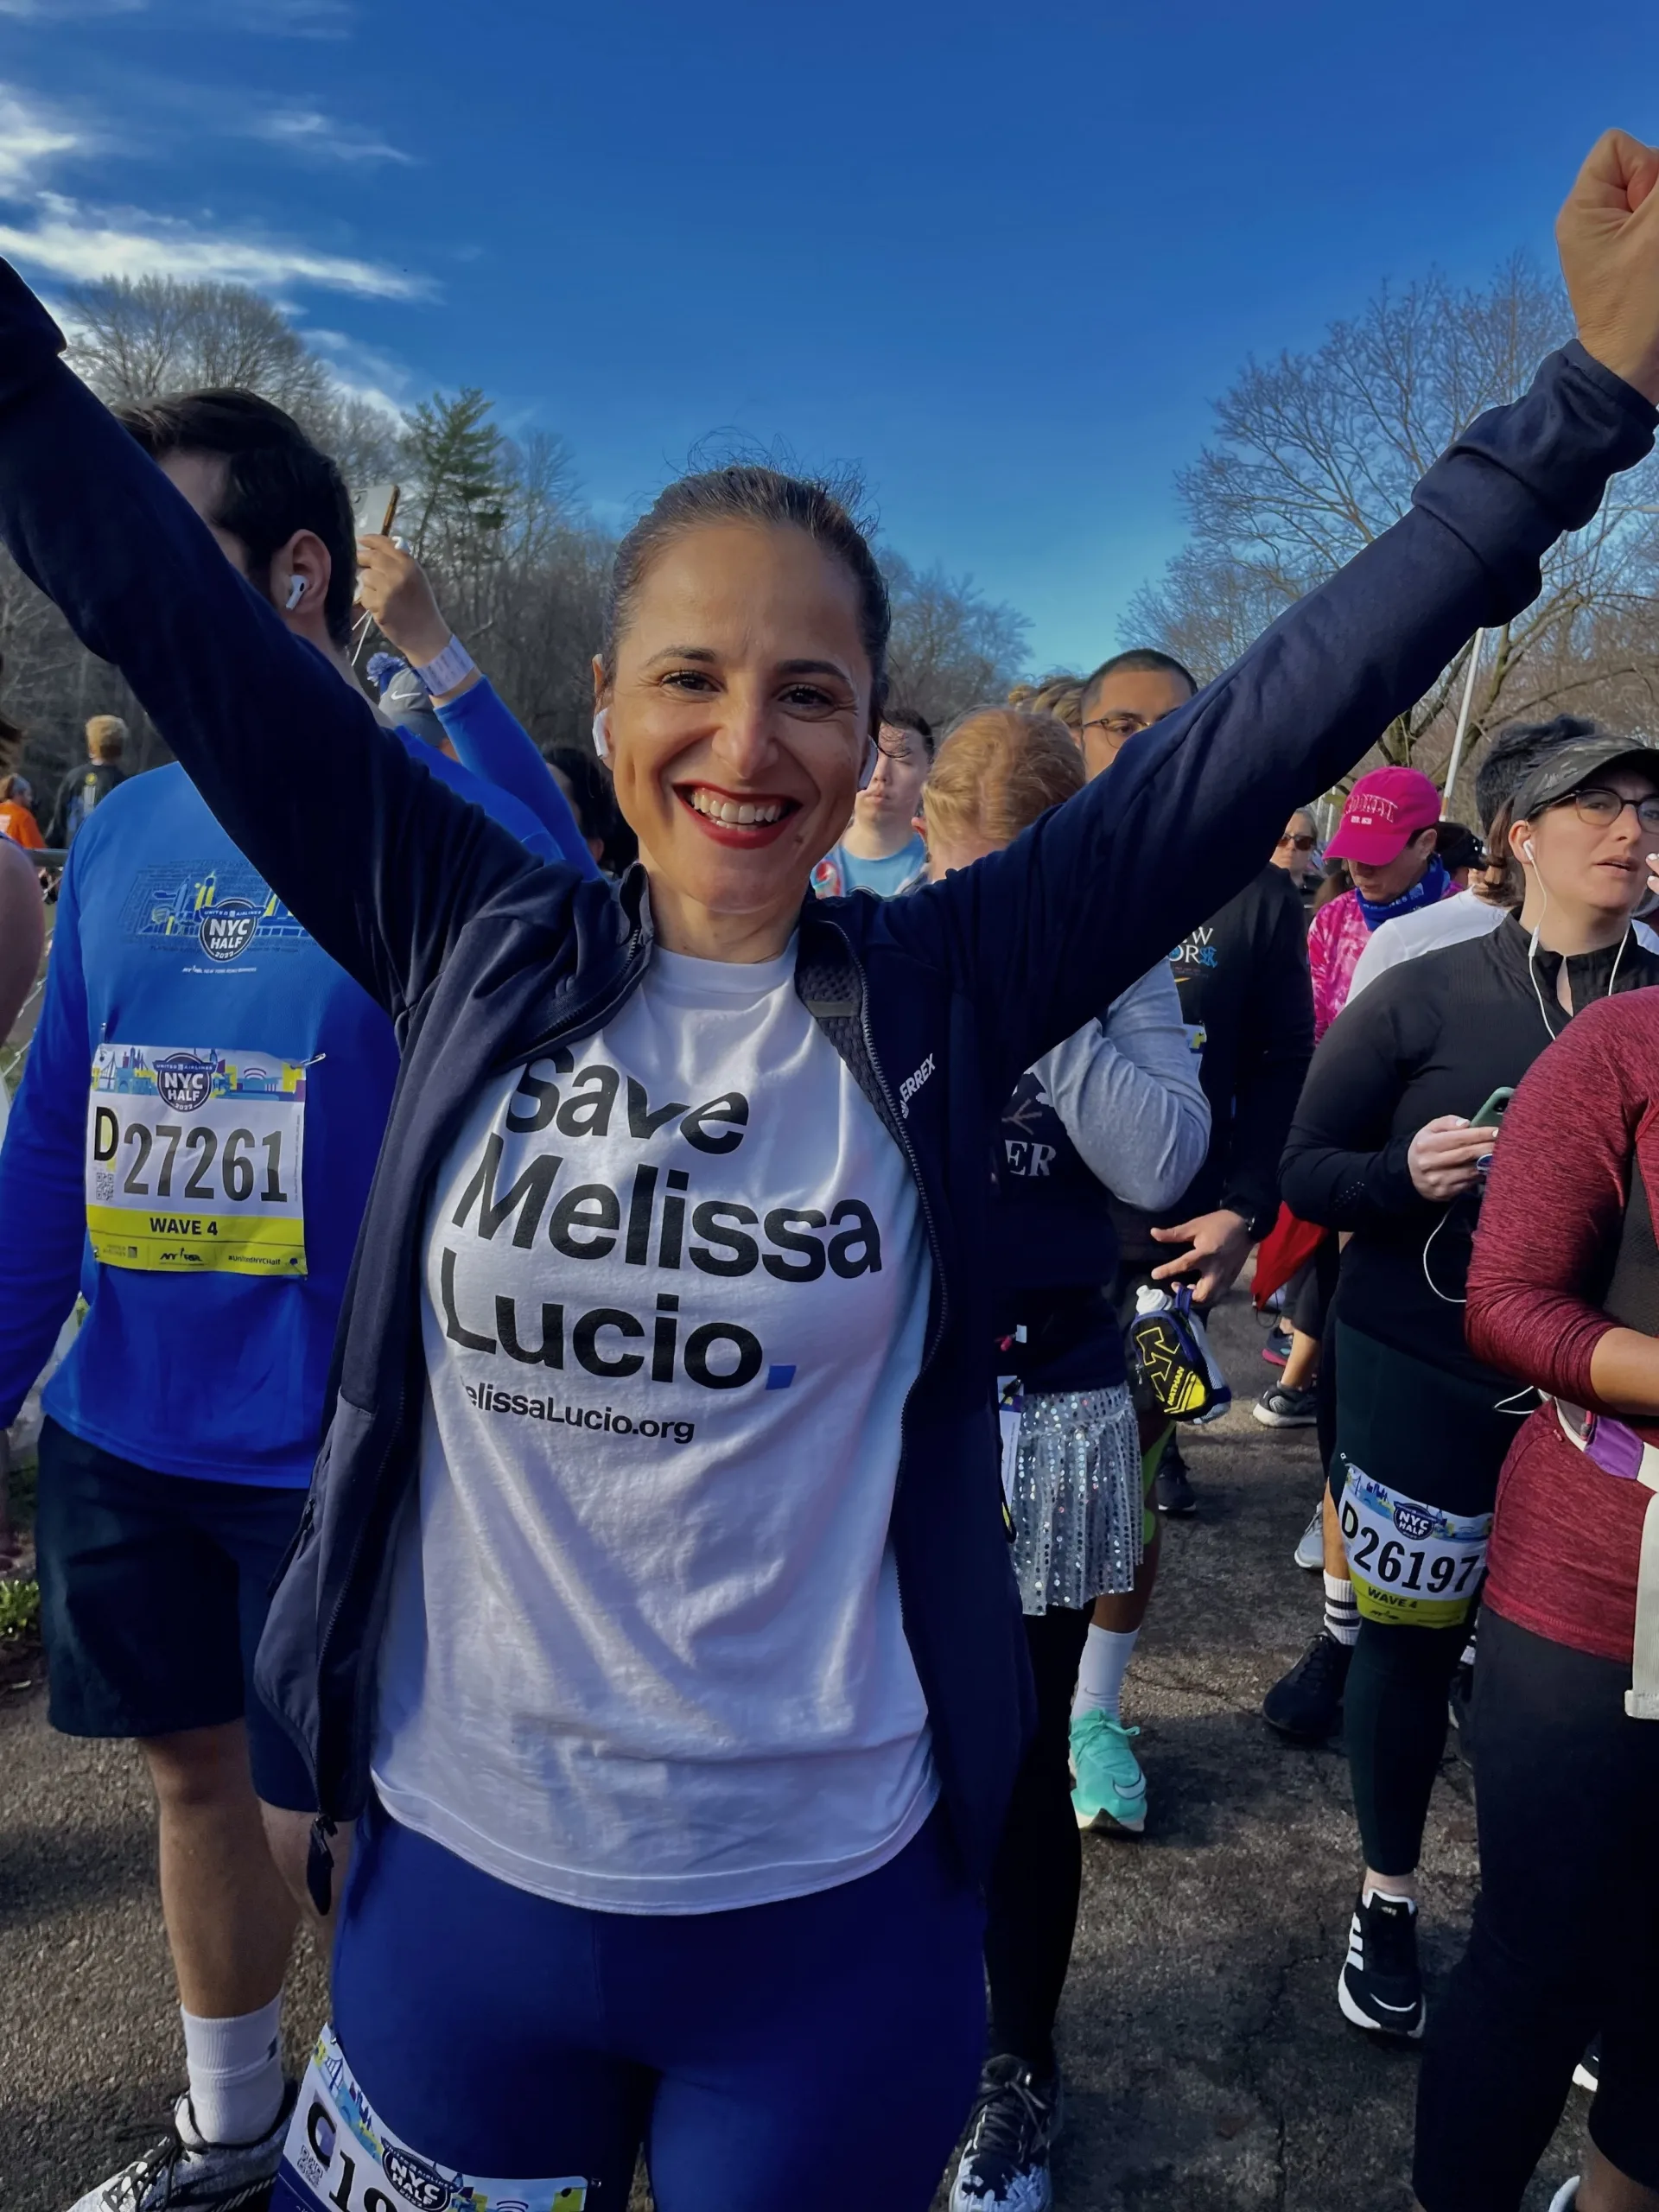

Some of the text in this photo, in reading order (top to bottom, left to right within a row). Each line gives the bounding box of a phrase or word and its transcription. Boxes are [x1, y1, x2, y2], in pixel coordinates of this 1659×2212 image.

[209, 918, 251, 937] NYC
[210, 937, 243, 950] HALF
[164, 1072, 204, 1090] NYC
[168, 1090, 200, 1102] HALF
[505, 1046, 749, 1155] Save
[451, 1131, 883, 1283] Melissa
[149, 1217, 219, 1236] WAVE 4
[1166, 1365, 1185, 1406] NATHAN
[464, 1382, 695, 1444] elissaLucio.org
[1399, 1510, 1429, 1530] NYC
[1399, 1521, 1425, 1536] HALF
[1368, 1586, 1408, 1607] WAVE
[391, 2157, 441, 2201] NYC
[392, 2172, 433, 2205] HALF
